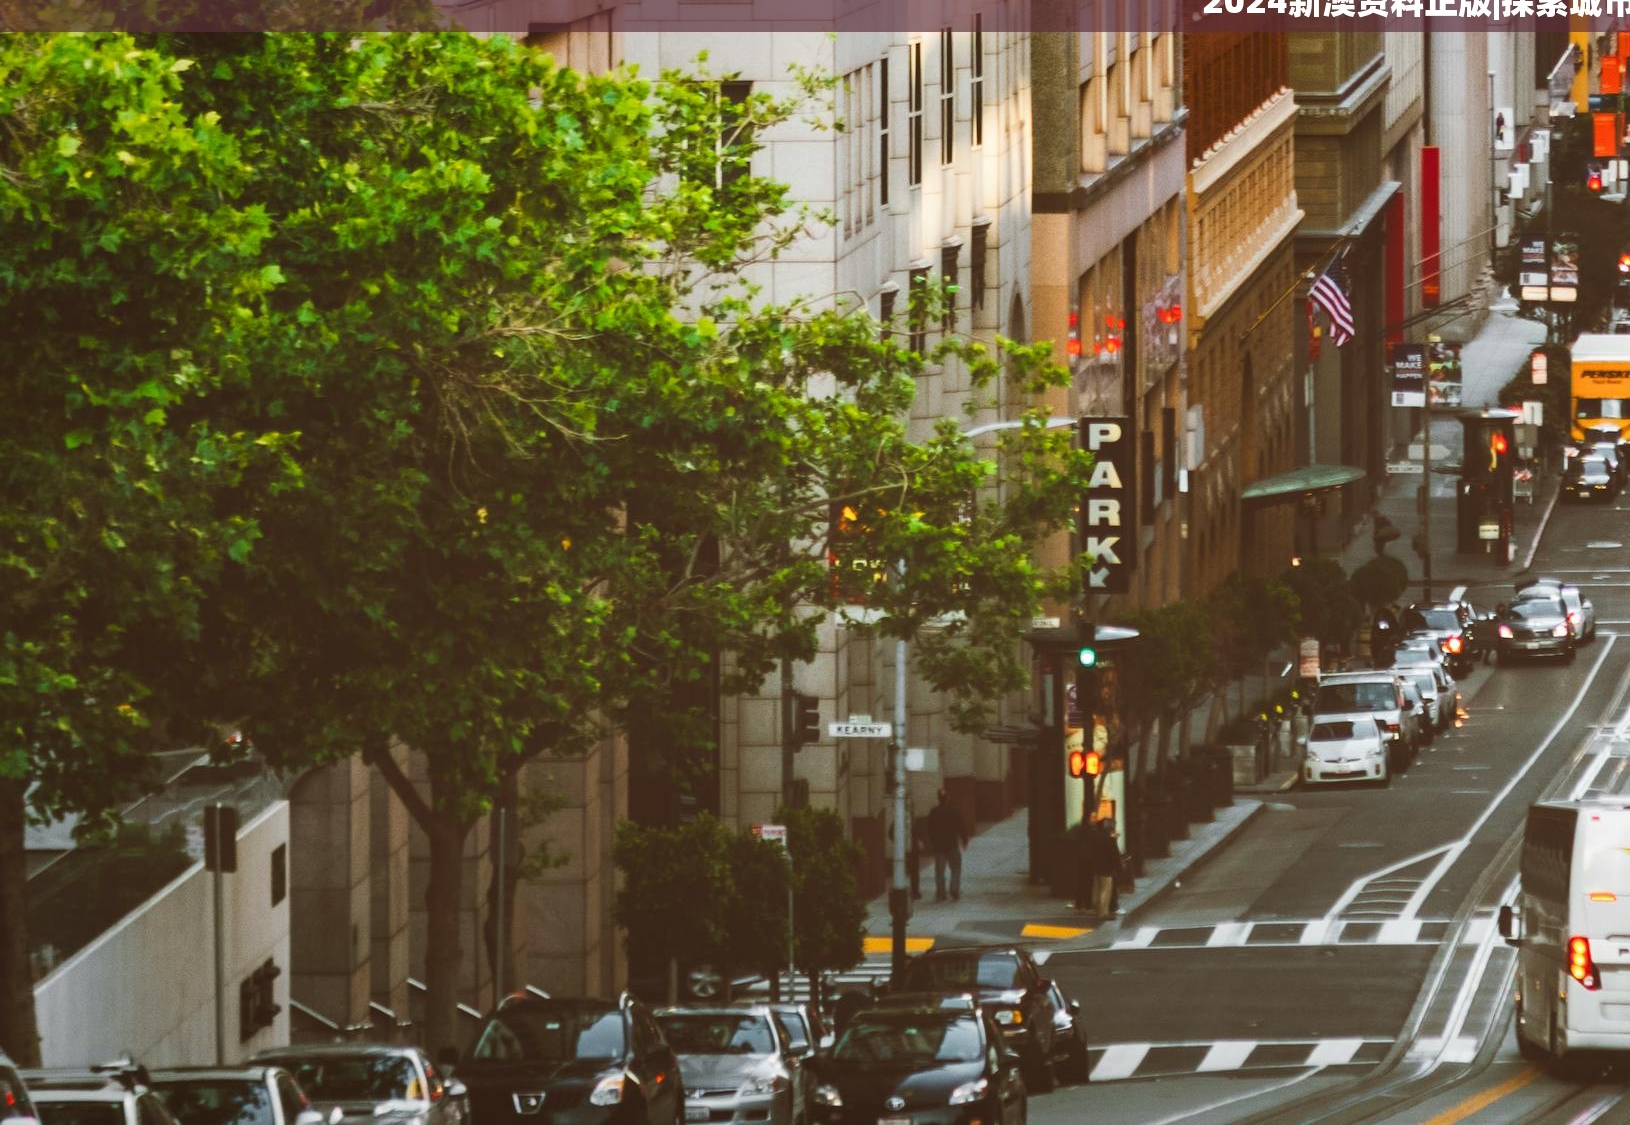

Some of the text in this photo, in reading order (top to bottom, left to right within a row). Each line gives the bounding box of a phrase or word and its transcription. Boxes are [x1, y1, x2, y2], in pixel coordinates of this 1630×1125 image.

[1395, 361, 1422, 369] MAKE
[1087, 423, 1123, 564] PARK
[837, 726, 882, 735] KEARNY
